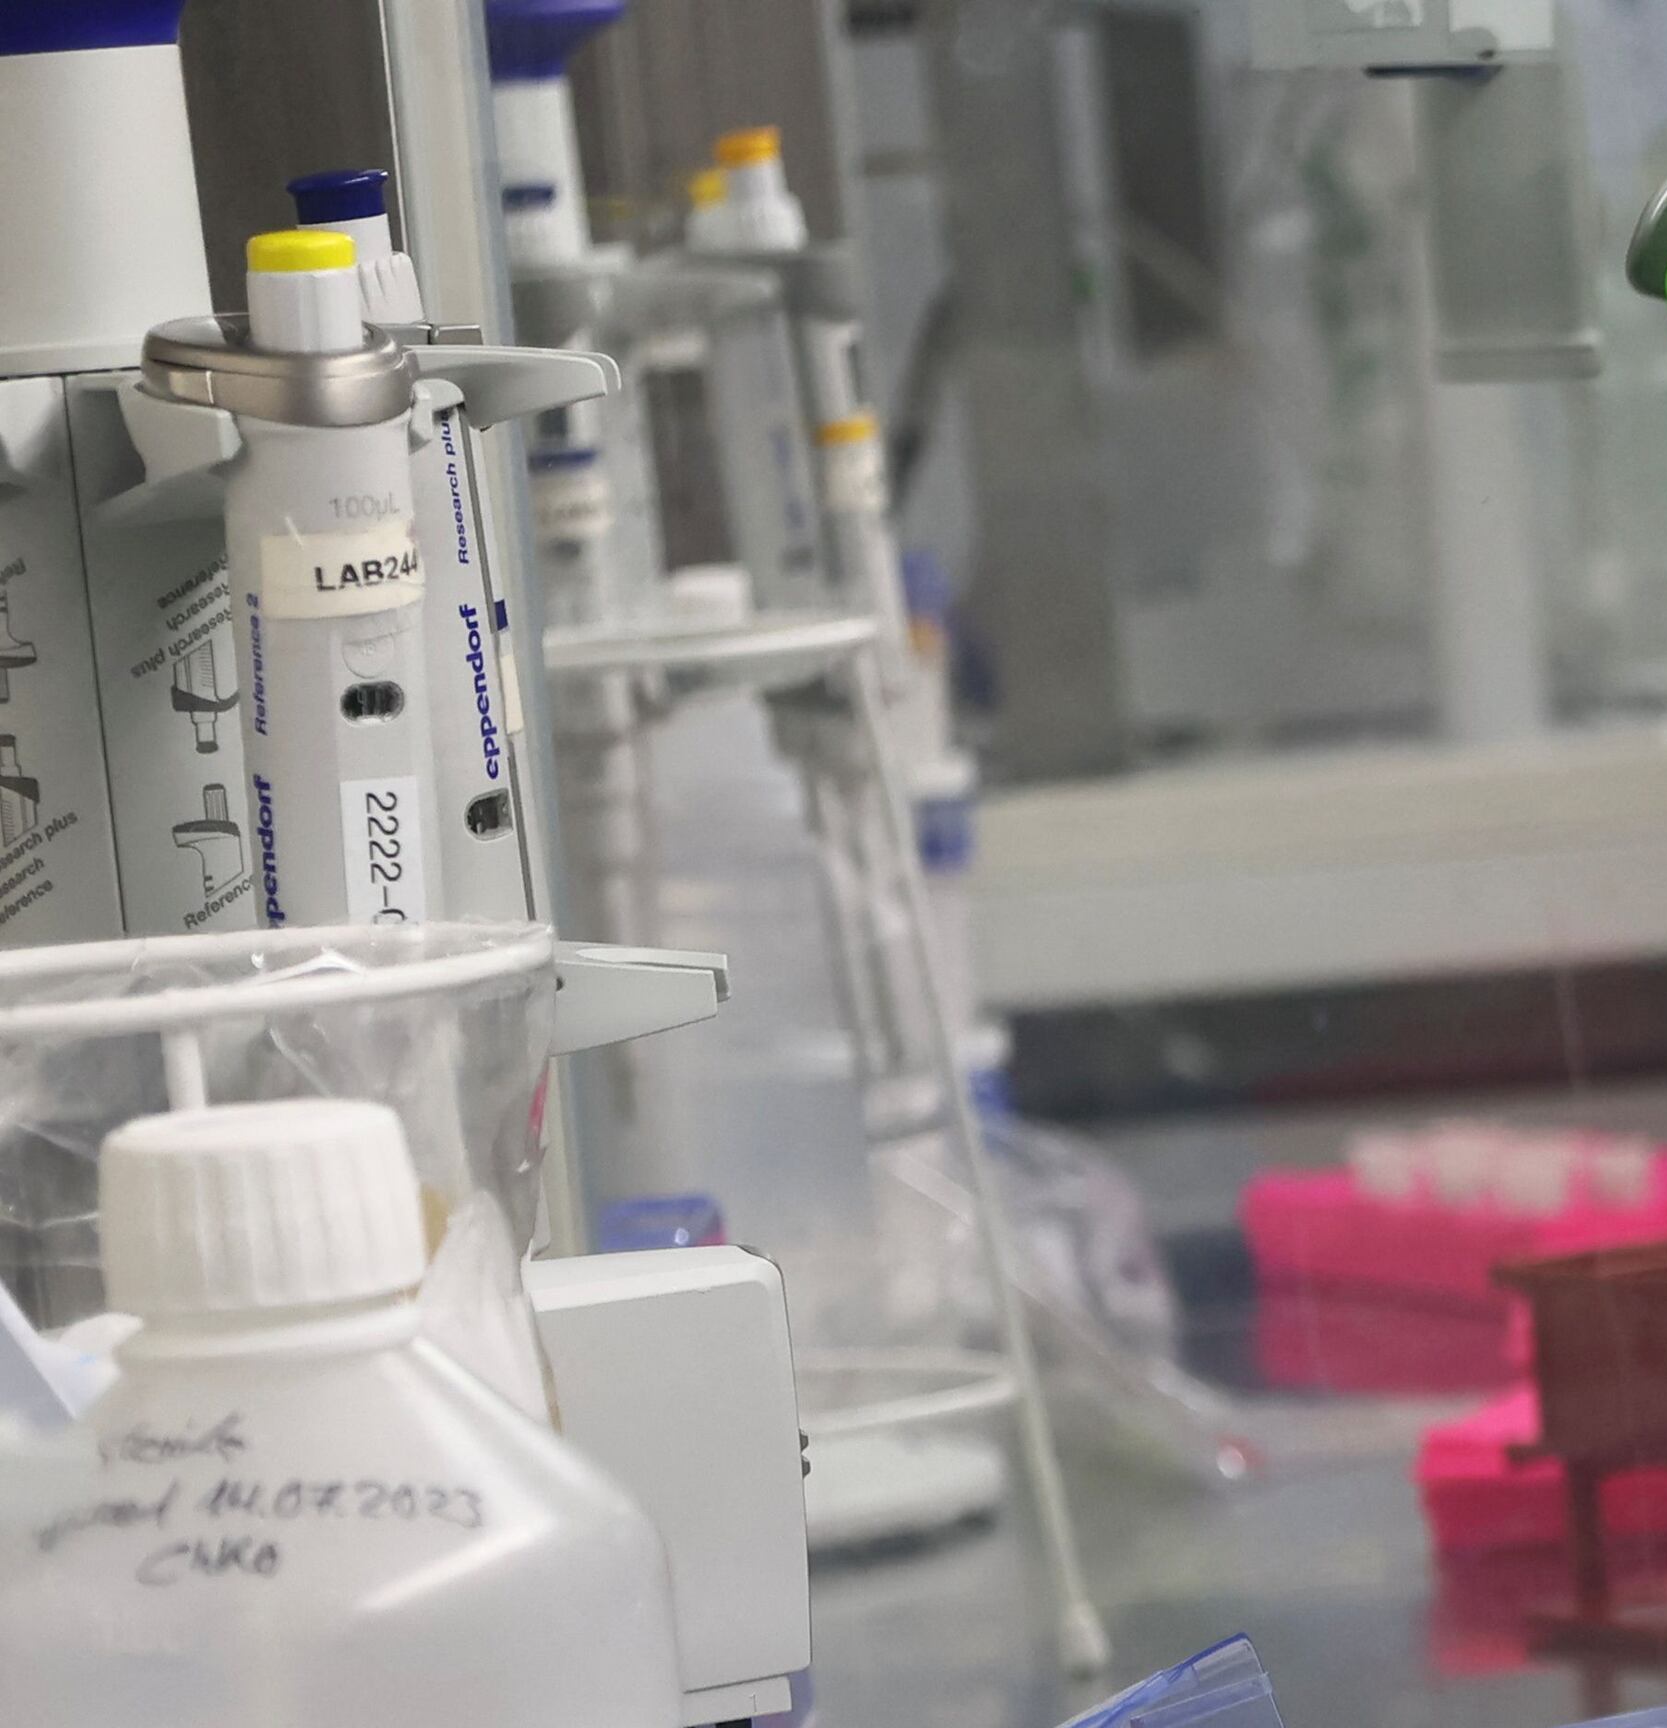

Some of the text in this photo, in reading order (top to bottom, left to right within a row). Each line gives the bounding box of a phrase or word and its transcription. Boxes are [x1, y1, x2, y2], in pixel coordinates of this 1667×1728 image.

[446, 463, 470, 564] Research
[250, 612, 268, 735] Reference
[459, 604, 501, 780] eppendorf
[0, 811, 78, 870] search plus
[0, 857, 45, 897] search
[253, 774, 285, 928] pendorf
[0, 880, 54, 924] eference
[183, 875, 254, 929] Referenc
